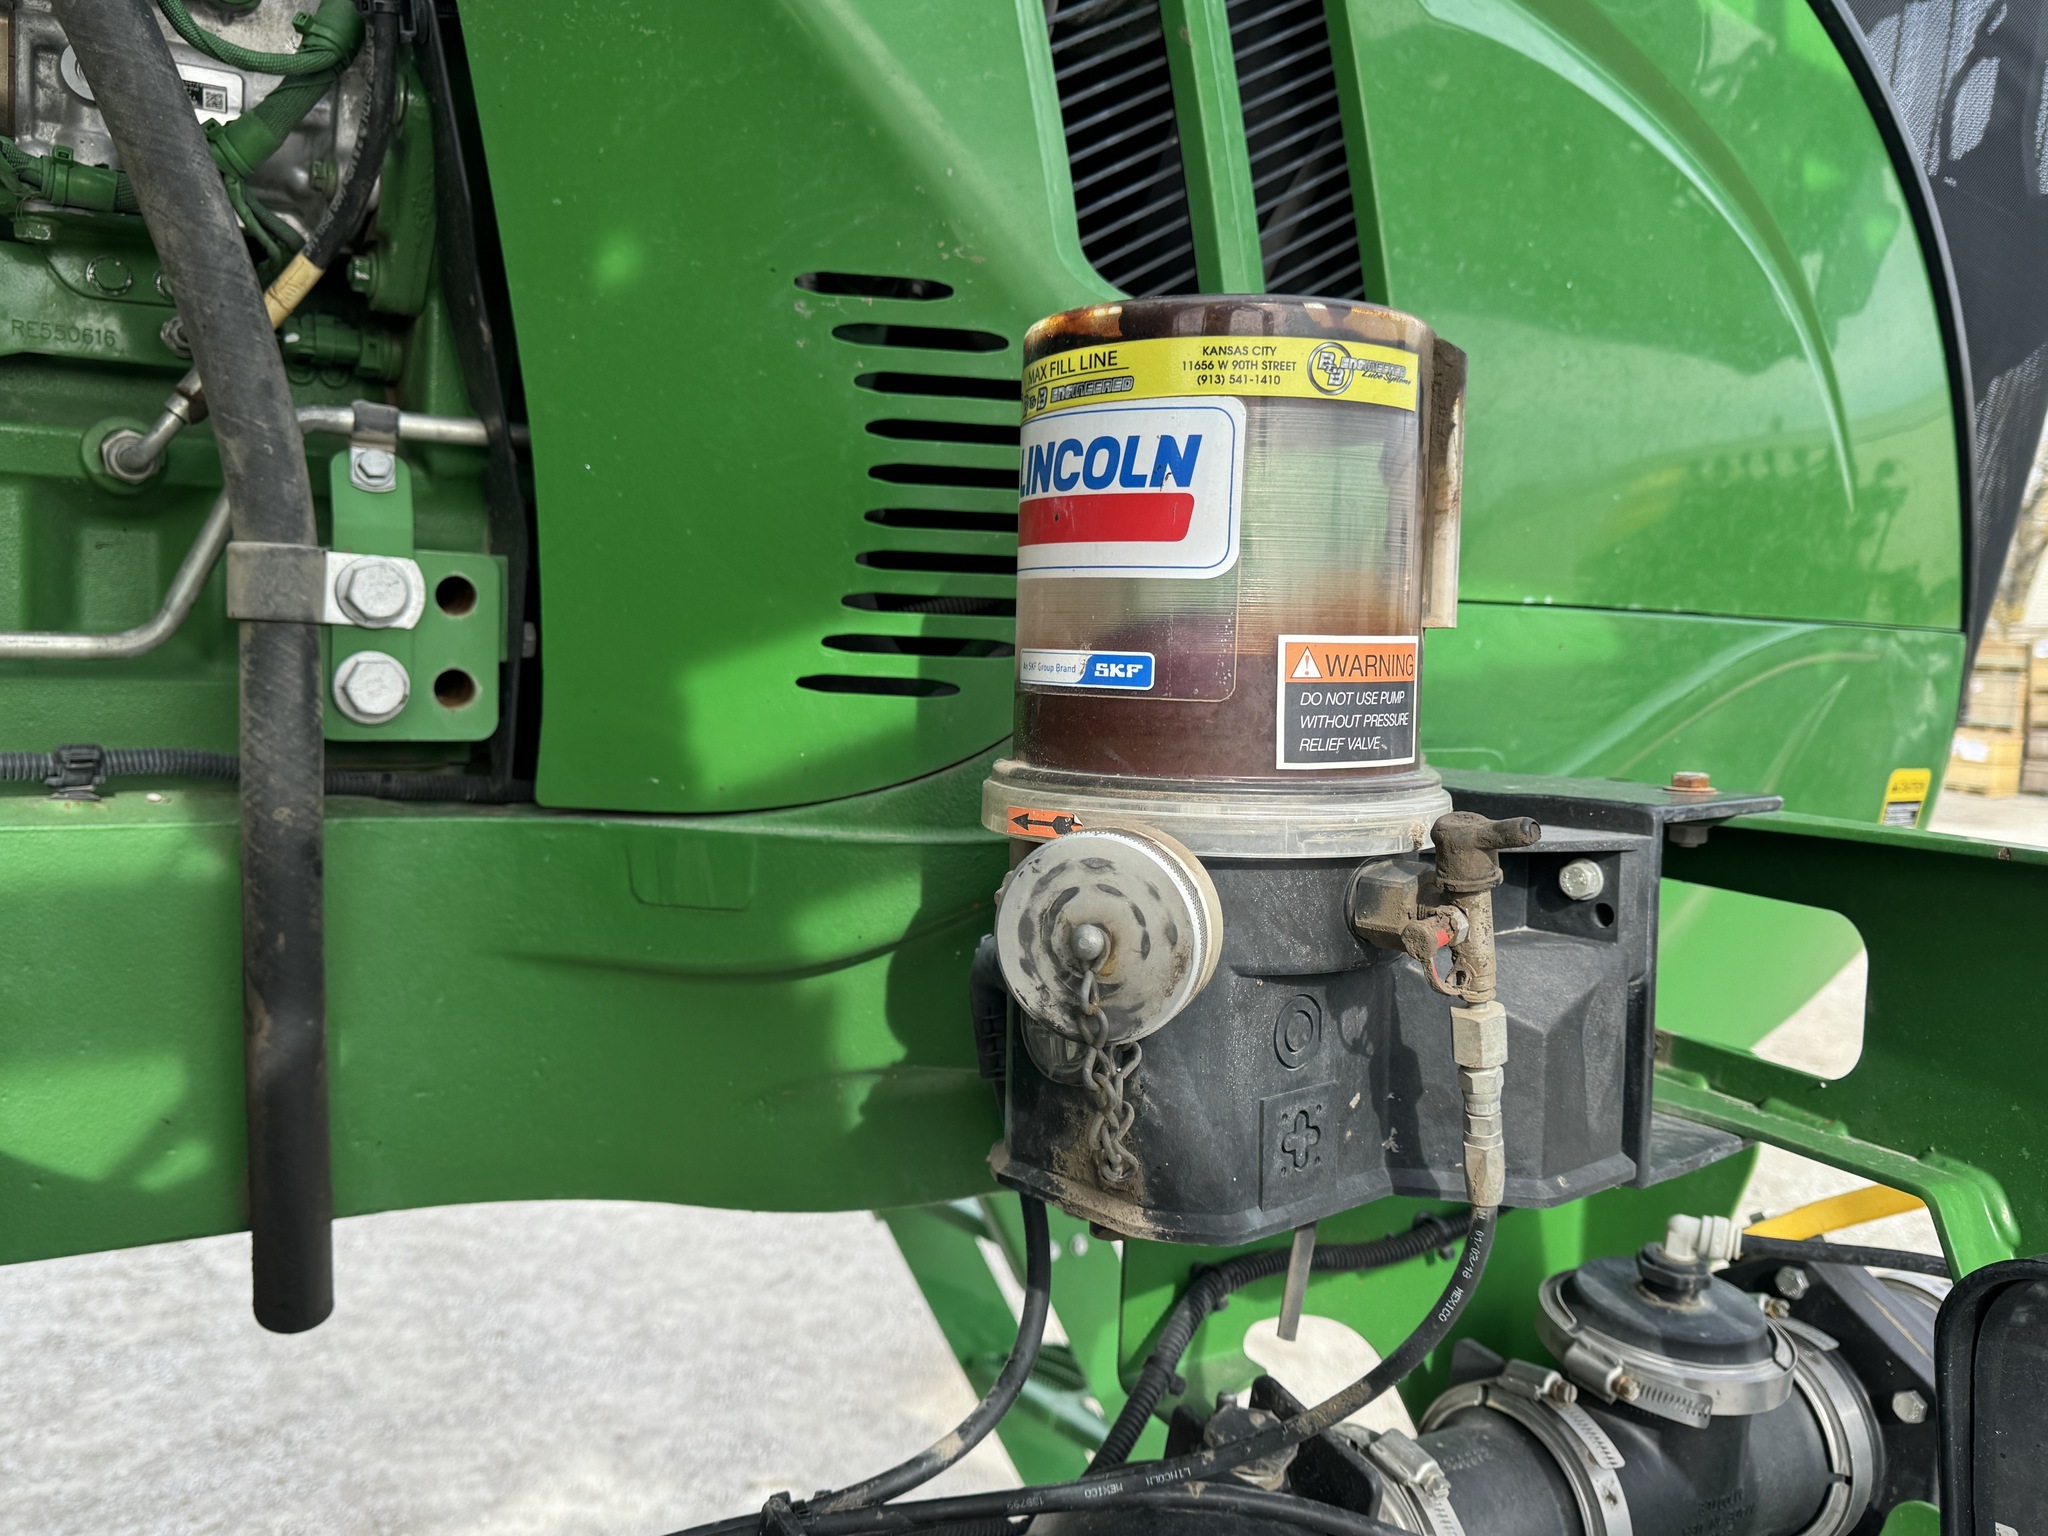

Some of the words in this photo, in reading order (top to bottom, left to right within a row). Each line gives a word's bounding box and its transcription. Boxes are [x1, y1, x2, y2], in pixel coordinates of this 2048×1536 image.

[11, 318, 117, 347] RE550616
[1202, 346, 1249, 356] KANSAS
[1252, 346, 1277, 356] CITY
[1028, 364, 1047, 389] MAX
[1049, 357, 1075, 378] FILL
[1080, 350, 1118, 371] LINE
[1182, 361, 1214, 371] 11656
[1218, 361, 1228, 370] W
[1232, 360, 1258, 370] 90TH
[1261, 361, 1297, 371] STREET
[1197, 374, 1225, 386] (913)
[1229, 374, 1281, 385] 541-1410
[1020, 434, 1203, 498] LINCOLN
[1037, 662, 1054, 673] Group
[1055, 663, 1076, 673] Brand
[1094, 663, 1143, 678] SKF
[1325, 654, 1414, 677] WARNING
[1300, 692, 1323, 706] DO
[1325, 692, 1354, 706] NOT
[1356, 691, 1379, 705] USE
[1380, 690, 1405, 705] PUMP
[1300, 714, 1362, 729] WITHOUT
[1363, 712, 1410, 728] PRESSURE
[1299, 737, 1346, 752] RELIEF
[1347, 736, 1381, 750] VALVE
[1438, 1286, 1464, 1322] MEXICO
[1084, 1482, 1124, 1498] MEXICO
